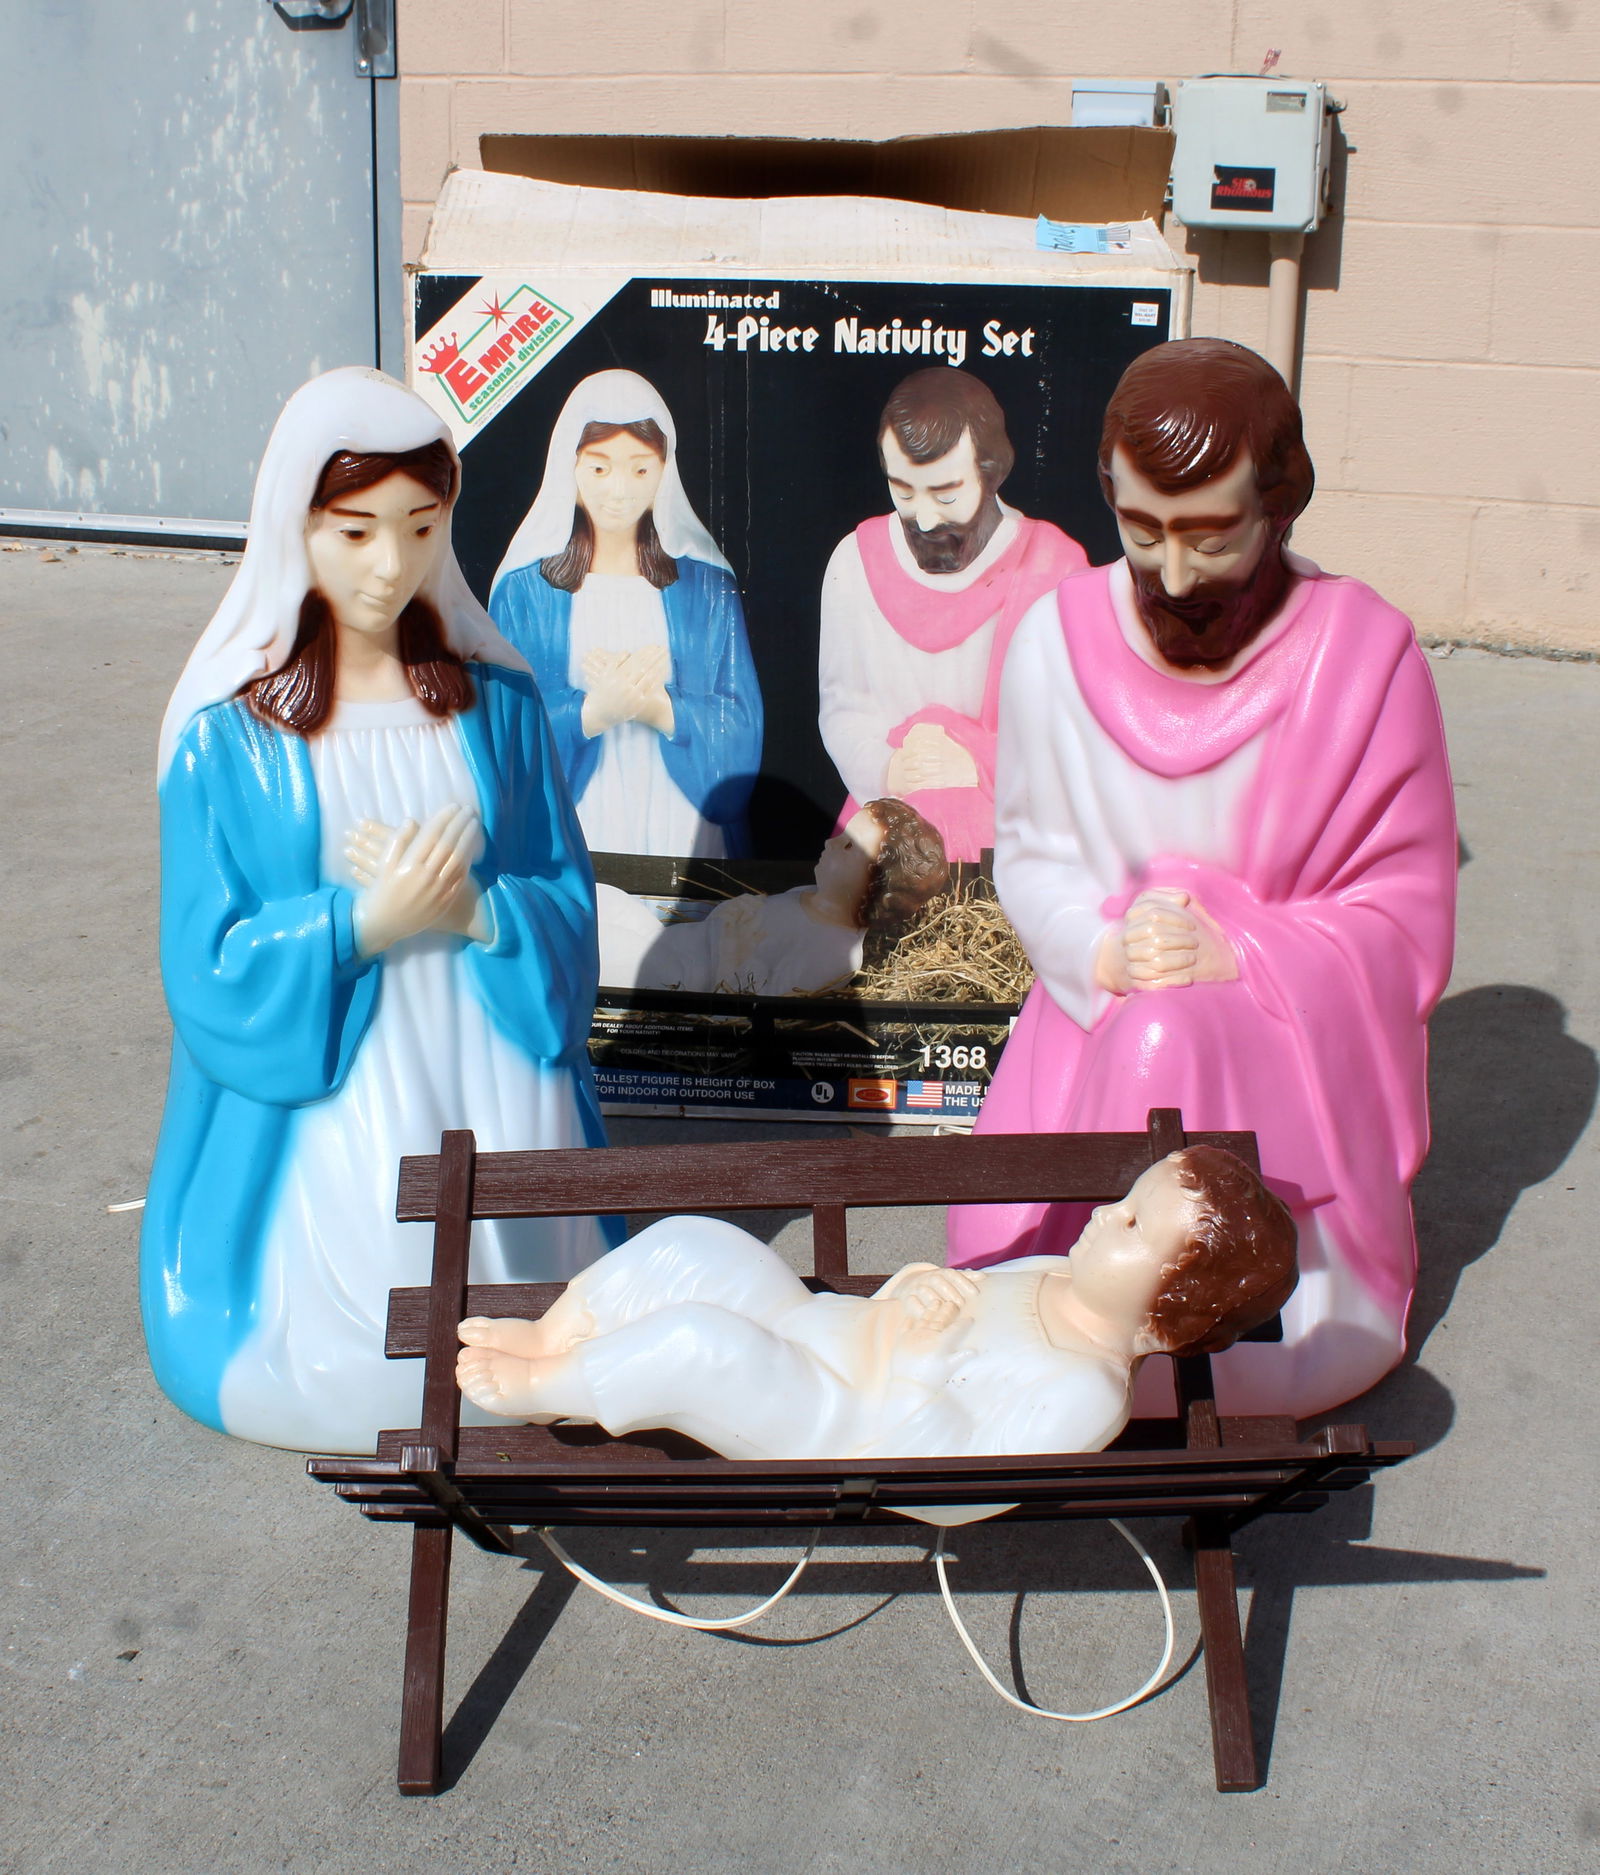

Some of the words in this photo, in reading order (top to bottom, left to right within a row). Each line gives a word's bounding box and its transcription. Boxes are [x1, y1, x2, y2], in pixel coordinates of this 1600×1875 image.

[650, 289, 780, 309] Illuminated
[517, 318, 561, 362] division
[703, 315, 819, 352] 4-Piece
[834, 317, 966, 367] Nativity
[981, 319, 1036, 358] Set
[444, 301, 554, 405] EMPIRE
[919, 1045, 986, 1070] 1368
[593, 1073, 639, 1084] TALLEST
[641, 1075, 680, 1086] FIGURE
[682, 1077, 693, 1086] IS
[695, 1077, 733, 1088] HEIGHT
[736, 1079, 751, 1088] OF
[753, 1080, 776, 1090] BOX
[945, 1084, 981, 1096] MADE
[983, 1085, 990, 1096] I
[594, 1085, 615, 1095] FOR
[618, 1086, 659, 1096] INDOOR
[661, 1088, 677, 1097] OR
[679, 1089, 732, 1099] OUTDOOR
[734, 1091, 756, 1101] USE
[943, 1096, 969, 1107] THE
